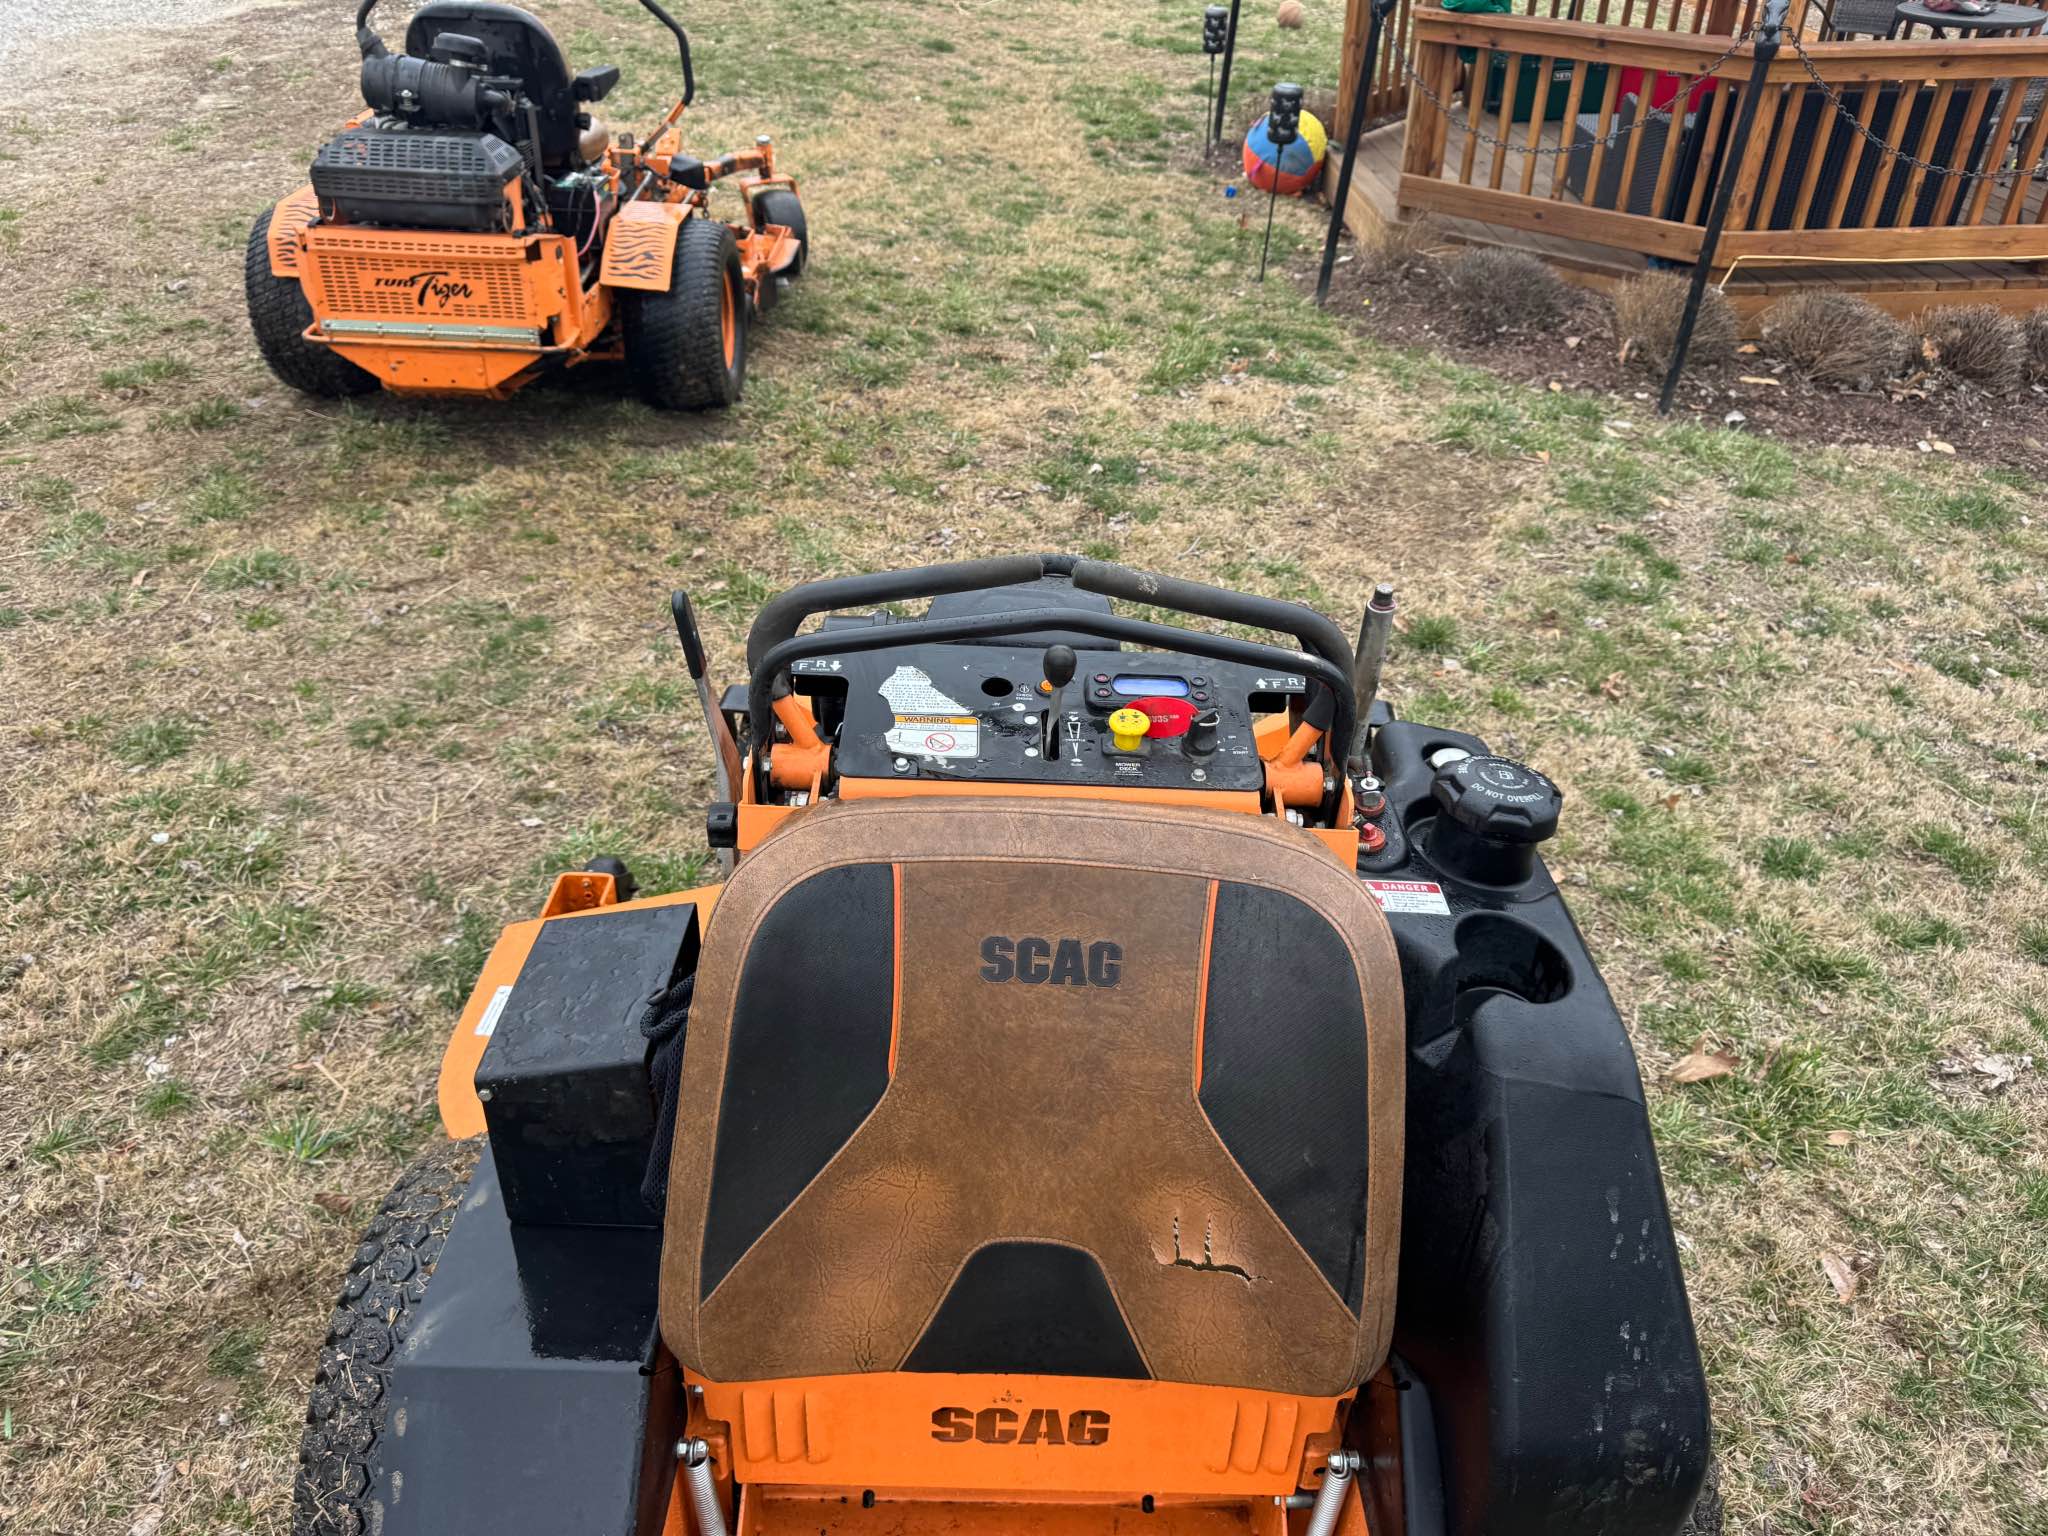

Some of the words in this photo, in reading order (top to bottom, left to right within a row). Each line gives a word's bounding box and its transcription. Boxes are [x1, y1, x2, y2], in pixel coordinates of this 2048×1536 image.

[410, 271, 473, 308] Tiger
[799, 662, 809, 671] F
[815, 660, 827, 668] R
[1272, 681, 1282, 689] F
[1287, 677, 1299, 686] R
[903, 716, 952, 724] WARNING
[1471, 782, 1485, 792] DO
[1485, 789, 1505, 800] NOT
[1507, 792, 1545, 803] OVERFILL
[1381, 882, 1429, 892] DANGER
[980, 936, 1124, 989] SCAG
[930, 1407, 1112, 1447] SCAG
